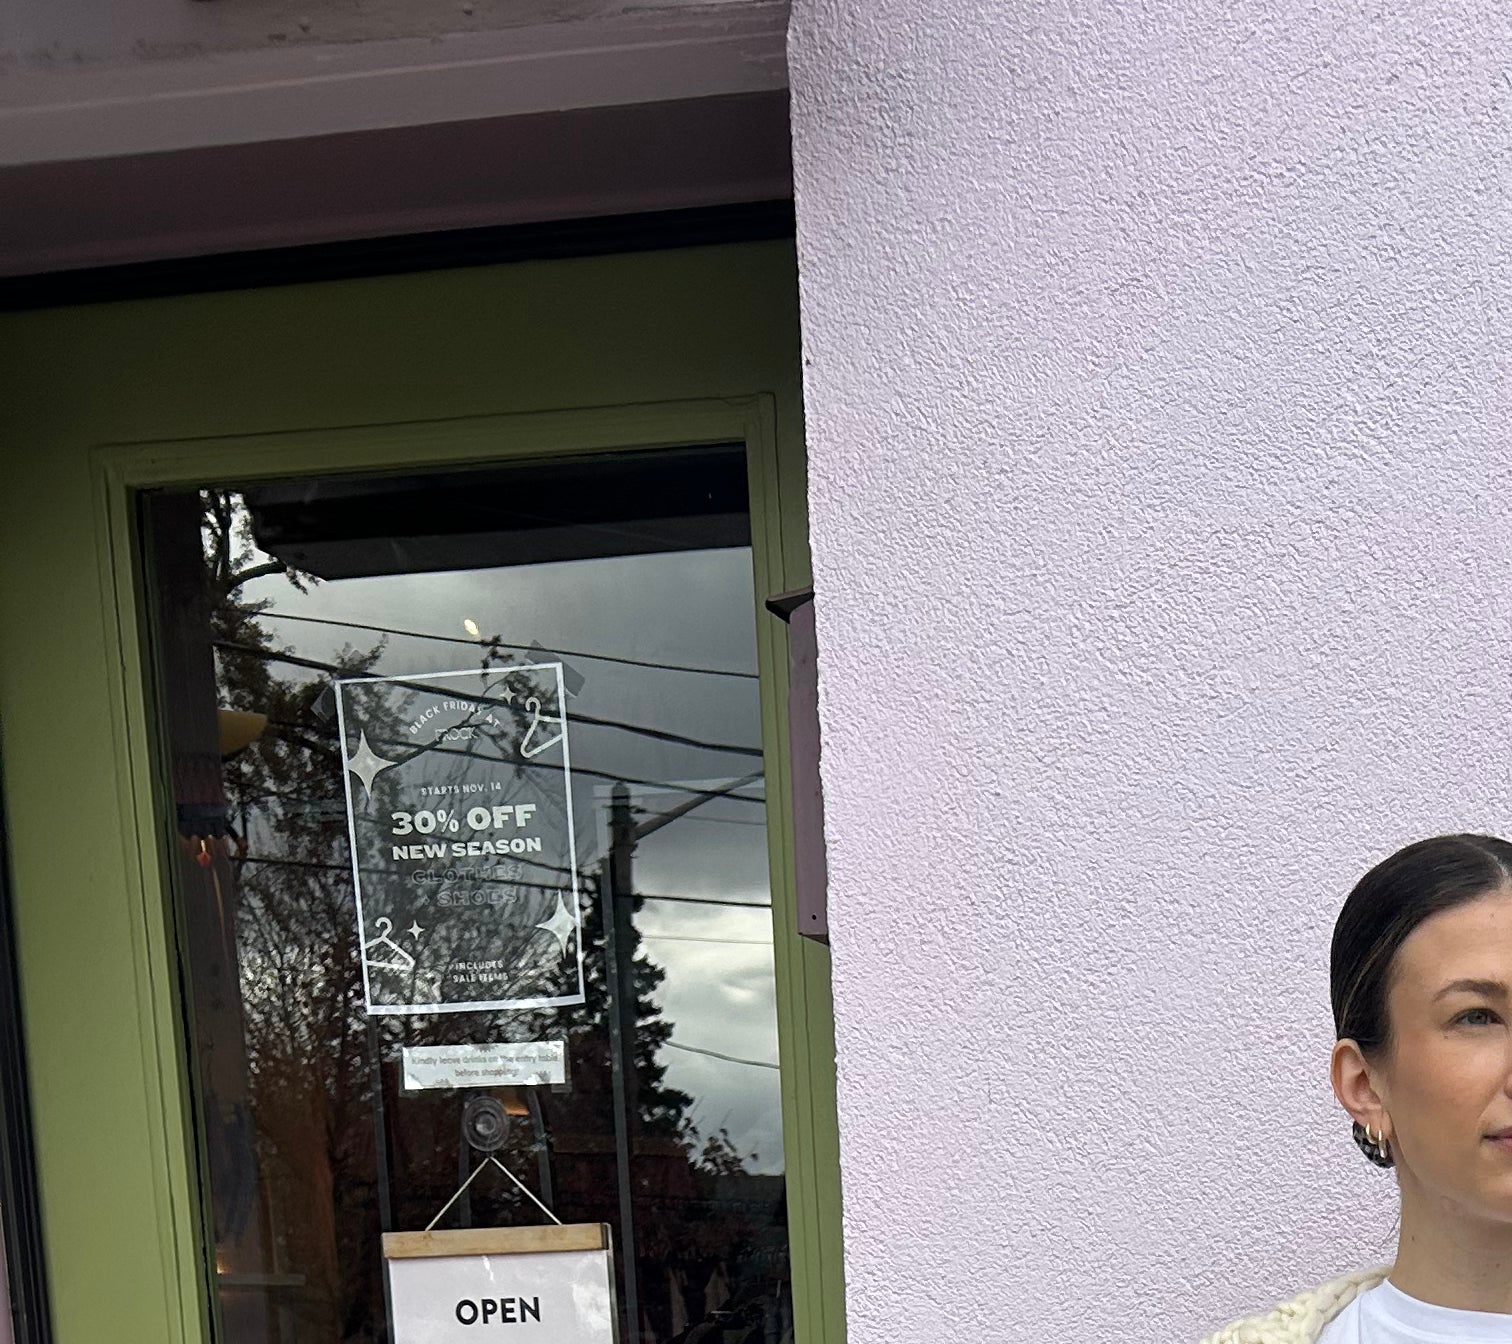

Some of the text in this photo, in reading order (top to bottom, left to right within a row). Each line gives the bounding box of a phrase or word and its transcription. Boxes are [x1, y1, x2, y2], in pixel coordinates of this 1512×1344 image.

[409, 705, 440, 734] BLACK
[485, 713, 500, 727] AT
[421, 785, 460, 797] STARTS
[463, 783, 488, 794] NOV.
[391, 804, 537, 835] 30% OFF
[392, 837, 542, 860] NEW SEASON
[412, 864, 523, 884] CLOTHES
[437, 887, 517, 907] SHOES
[411, 1057, 437, 1066] Kindly
[463, 1055, 487, 1064] drinks
[454, 1069, 479, 1077] before
[456, 1297, 541, 1325] OPEN
